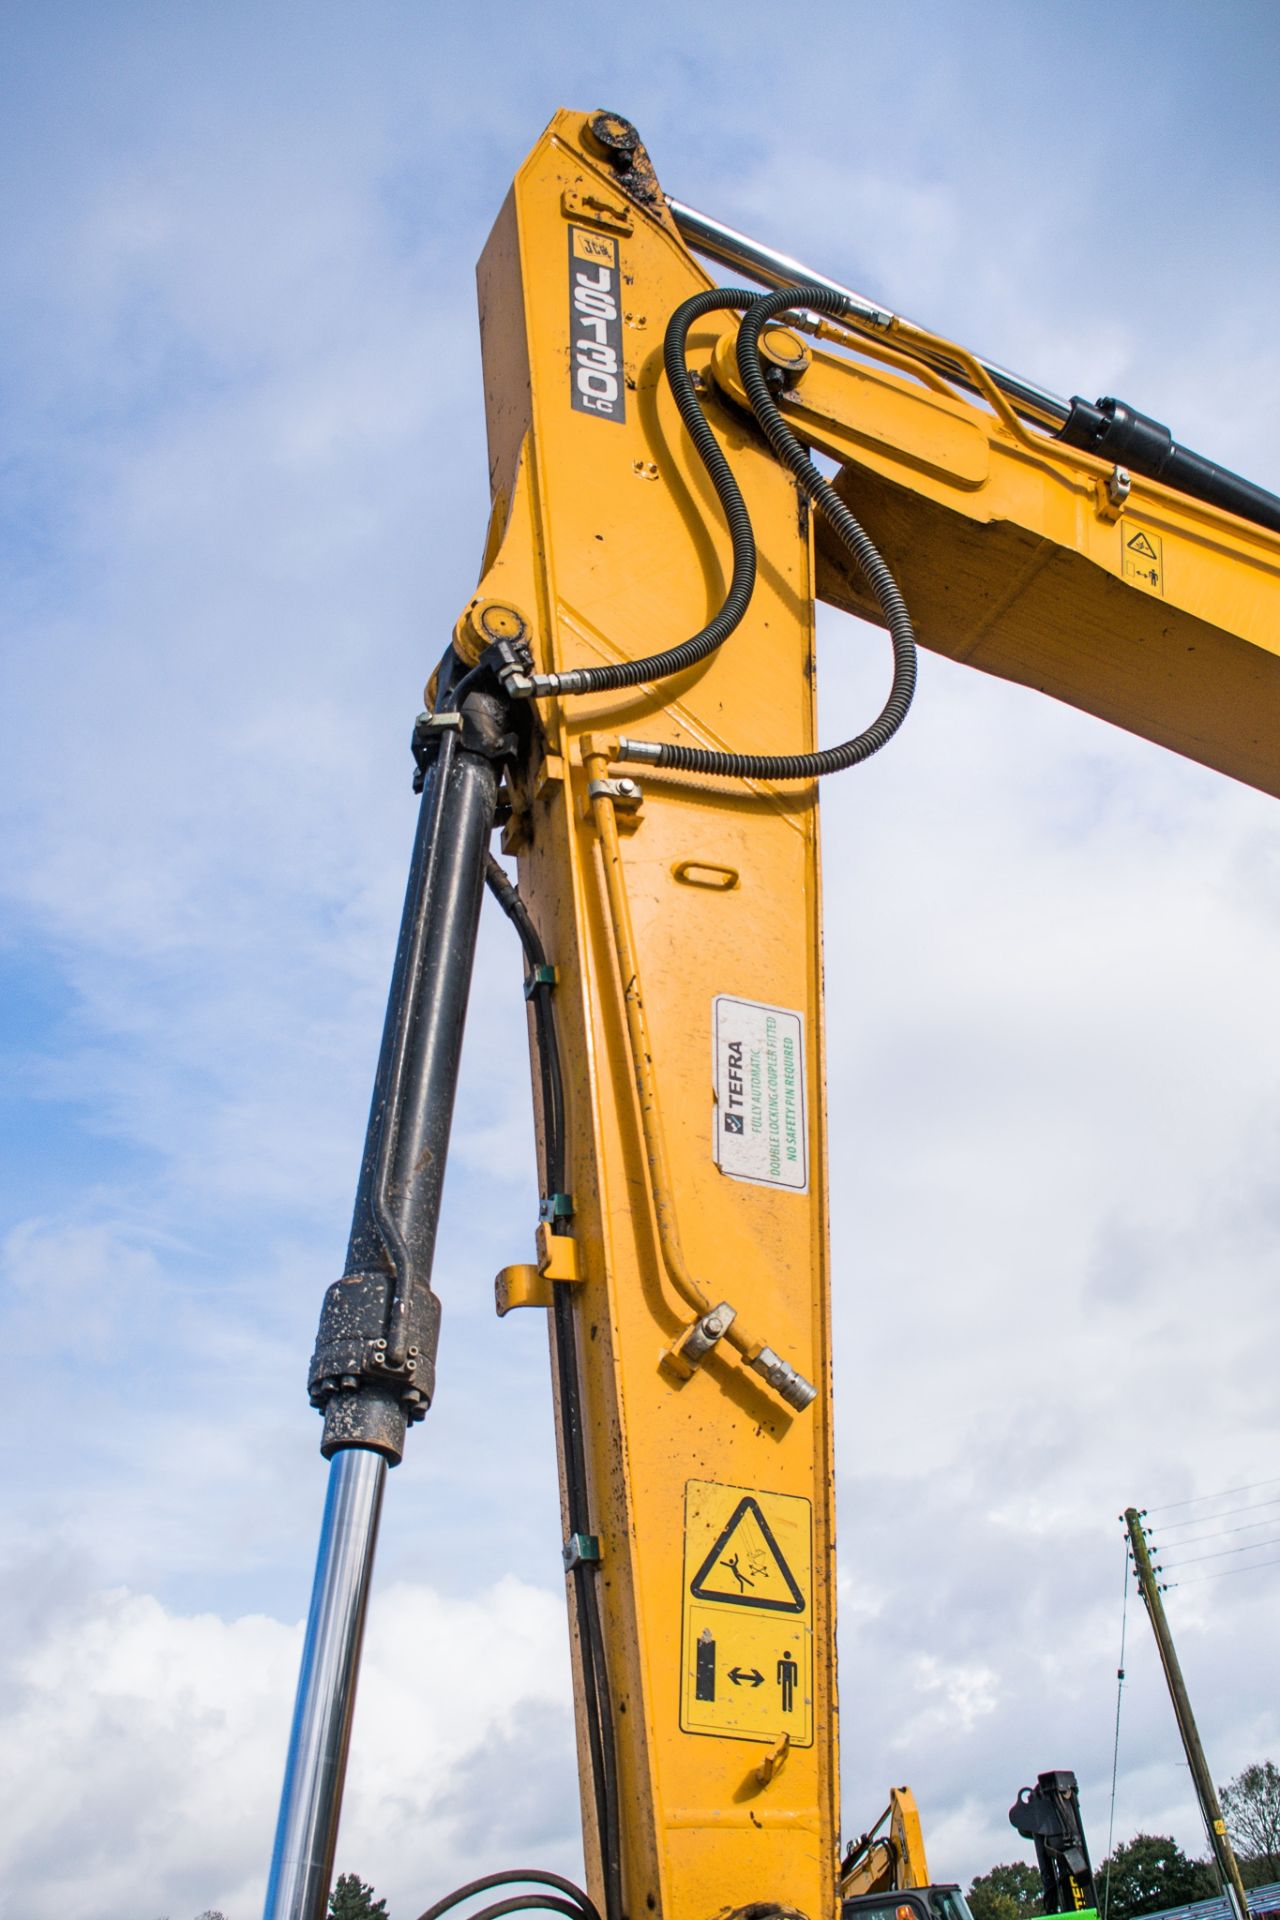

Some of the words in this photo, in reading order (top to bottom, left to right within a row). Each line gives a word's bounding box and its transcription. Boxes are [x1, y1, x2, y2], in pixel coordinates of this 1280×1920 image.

[574, 267, 618, 402] JS130
[583, 395, 613, 413] LC
[766, 1017, 776, 1047] FITTED
[728, 1041, 743, 1108] TEFRA
[750, 1049, 761, 1102] AUTOMATIC
[767, 1051, 778, 1093] COUPLER
[783, 1037, 794, 1086] REQUIRED
[769, 1094, 779, 1135] LOCKING
[785, 1087, 795, 1105] PIN
[752, 1106, 761, 1134] FULLY
[785, 1107, 796, 1146] SAFETY
[770, 1137, 780, 1176] DOUBLE
[786, 1147, 796, 1162] NO
